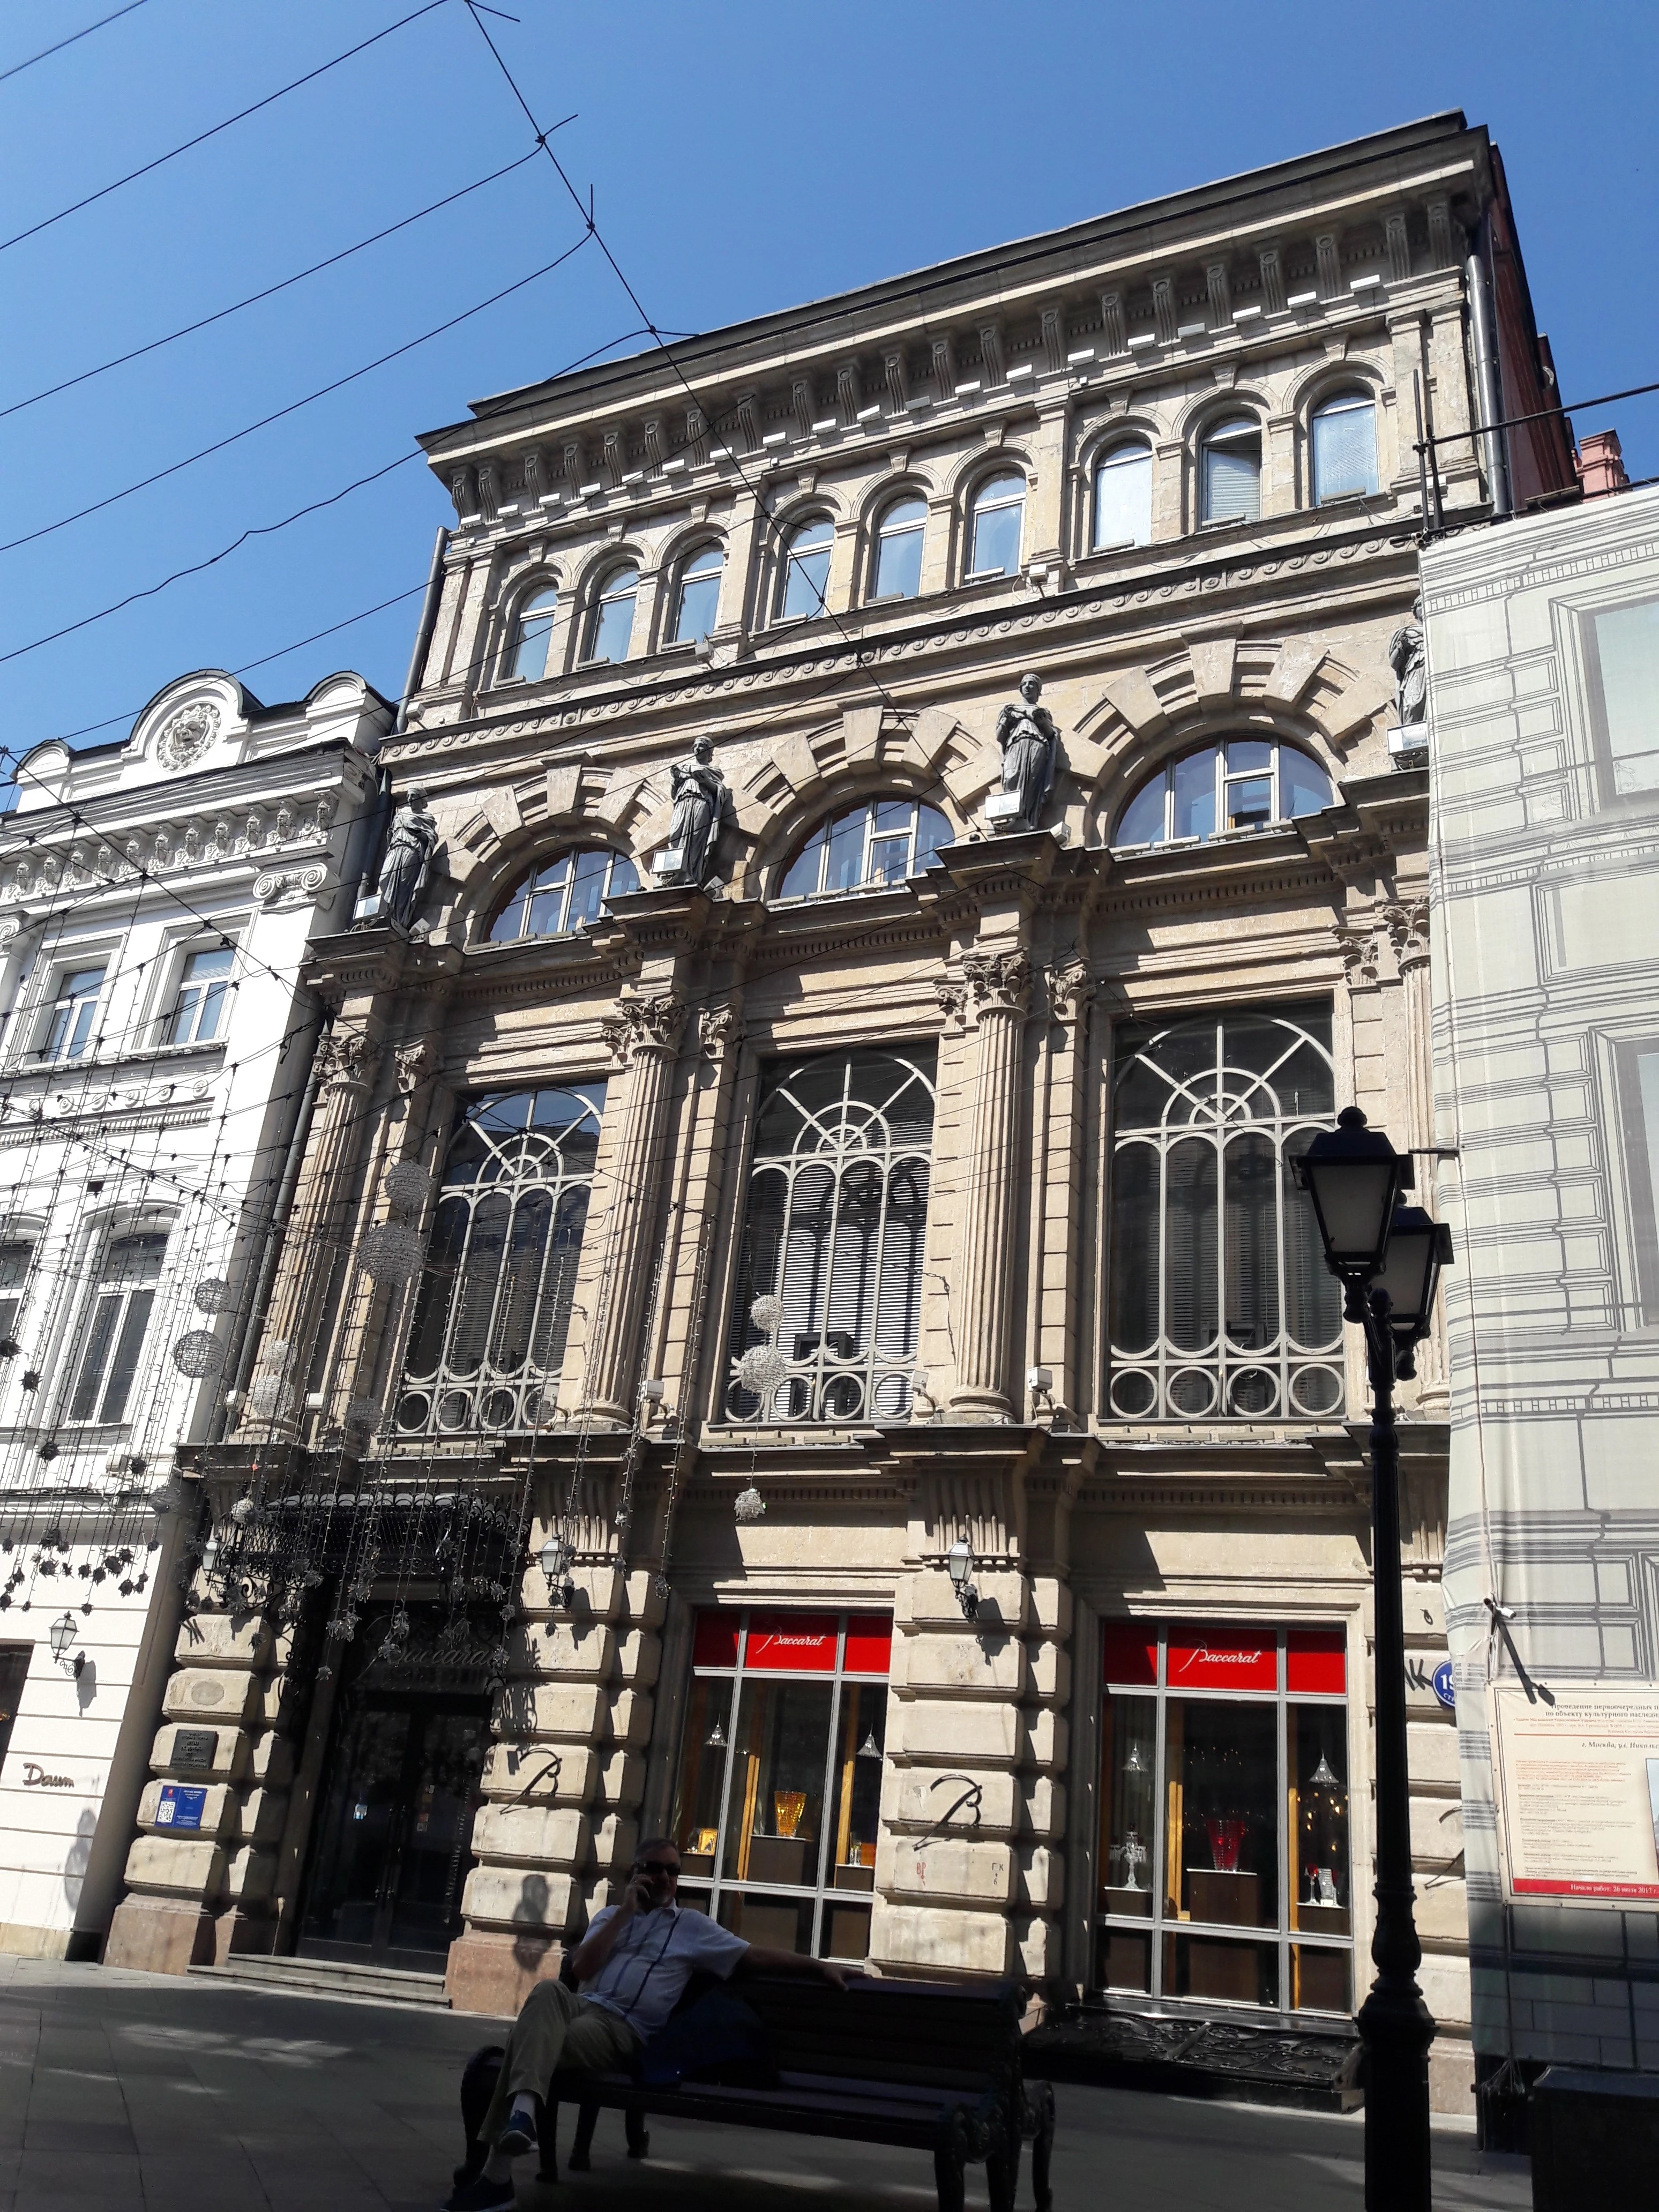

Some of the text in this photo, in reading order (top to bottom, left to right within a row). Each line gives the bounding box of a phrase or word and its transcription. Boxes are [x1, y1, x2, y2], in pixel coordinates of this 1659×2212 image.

[756, 1625, 826, 1654] Baccarat
[1178, 1639, 1261, 1672] Baccarat
[1555, 1710, 1582, 1718] объекту
[23, 1762, 74, 1788] Daum
